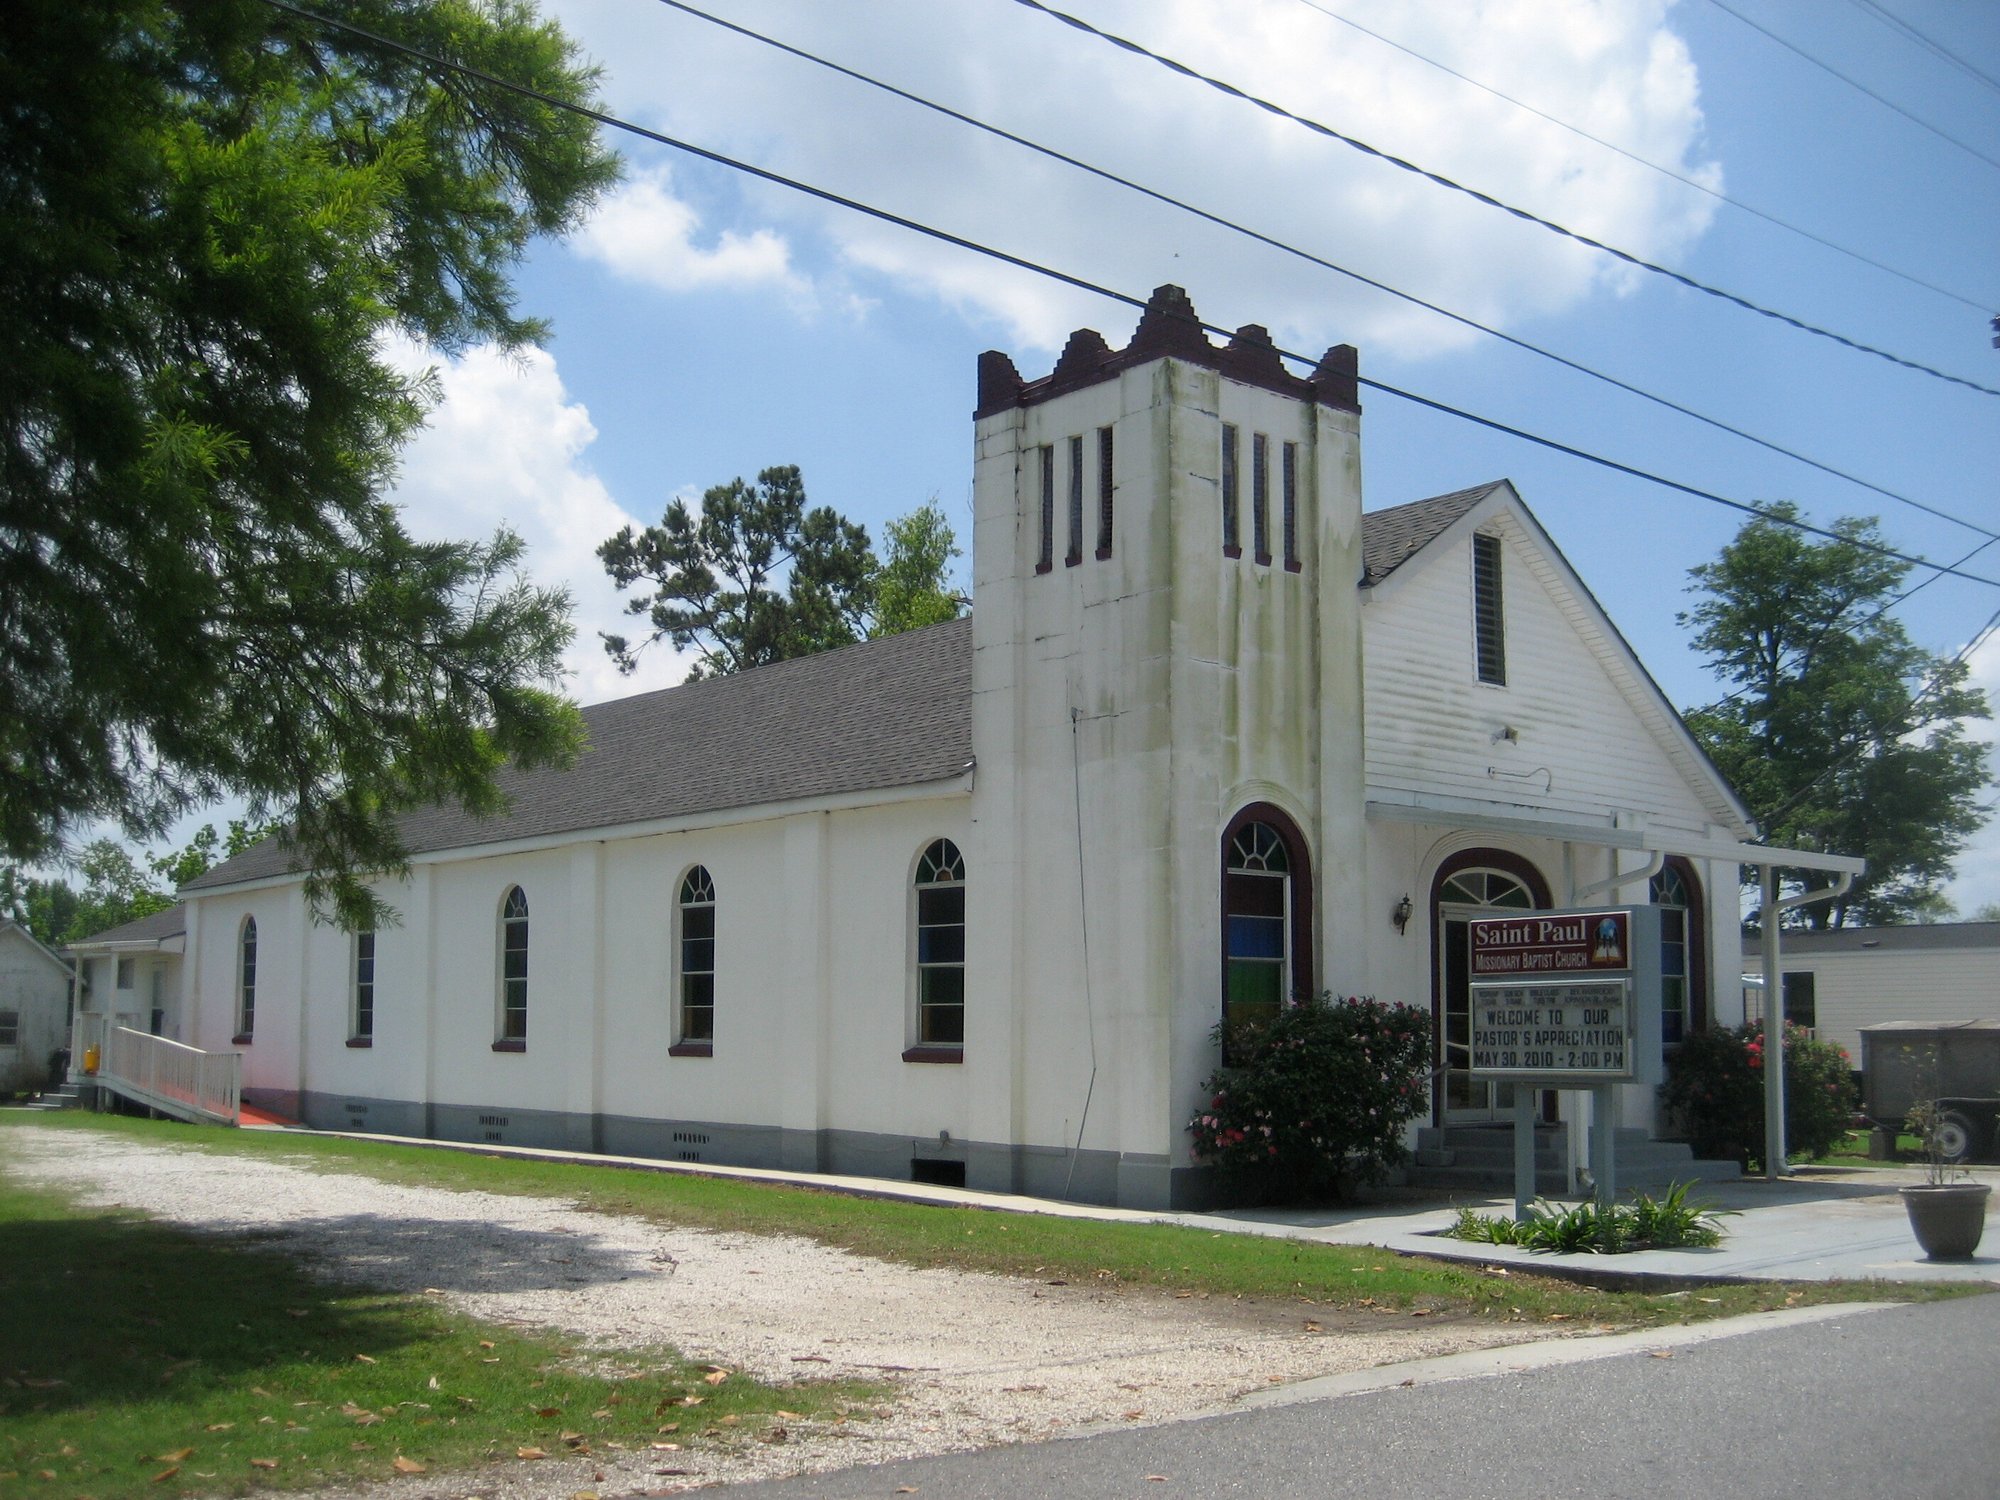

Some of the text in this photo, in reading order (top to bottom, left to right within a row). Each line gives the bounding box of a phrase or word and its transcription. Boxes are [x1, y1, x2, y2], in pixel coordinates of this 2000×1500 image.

[1476, 919, 1587, 945] Saint Paul
[1476, 950, 1587, 970] MISSIONARY BAPTIST CHURCH
[1487, 1008, 1609, 1025] WELCOME TO OUR
[1475, 1030, 1531, 1046] PASTOR'S
[1474, 1052, 1498, 1067] MAY
[1524, 1051, 1553, 1067] 2010
[1568, 1051, 1599, 1067] 2:00
[1603, 1051, 1623, 1067] PM
